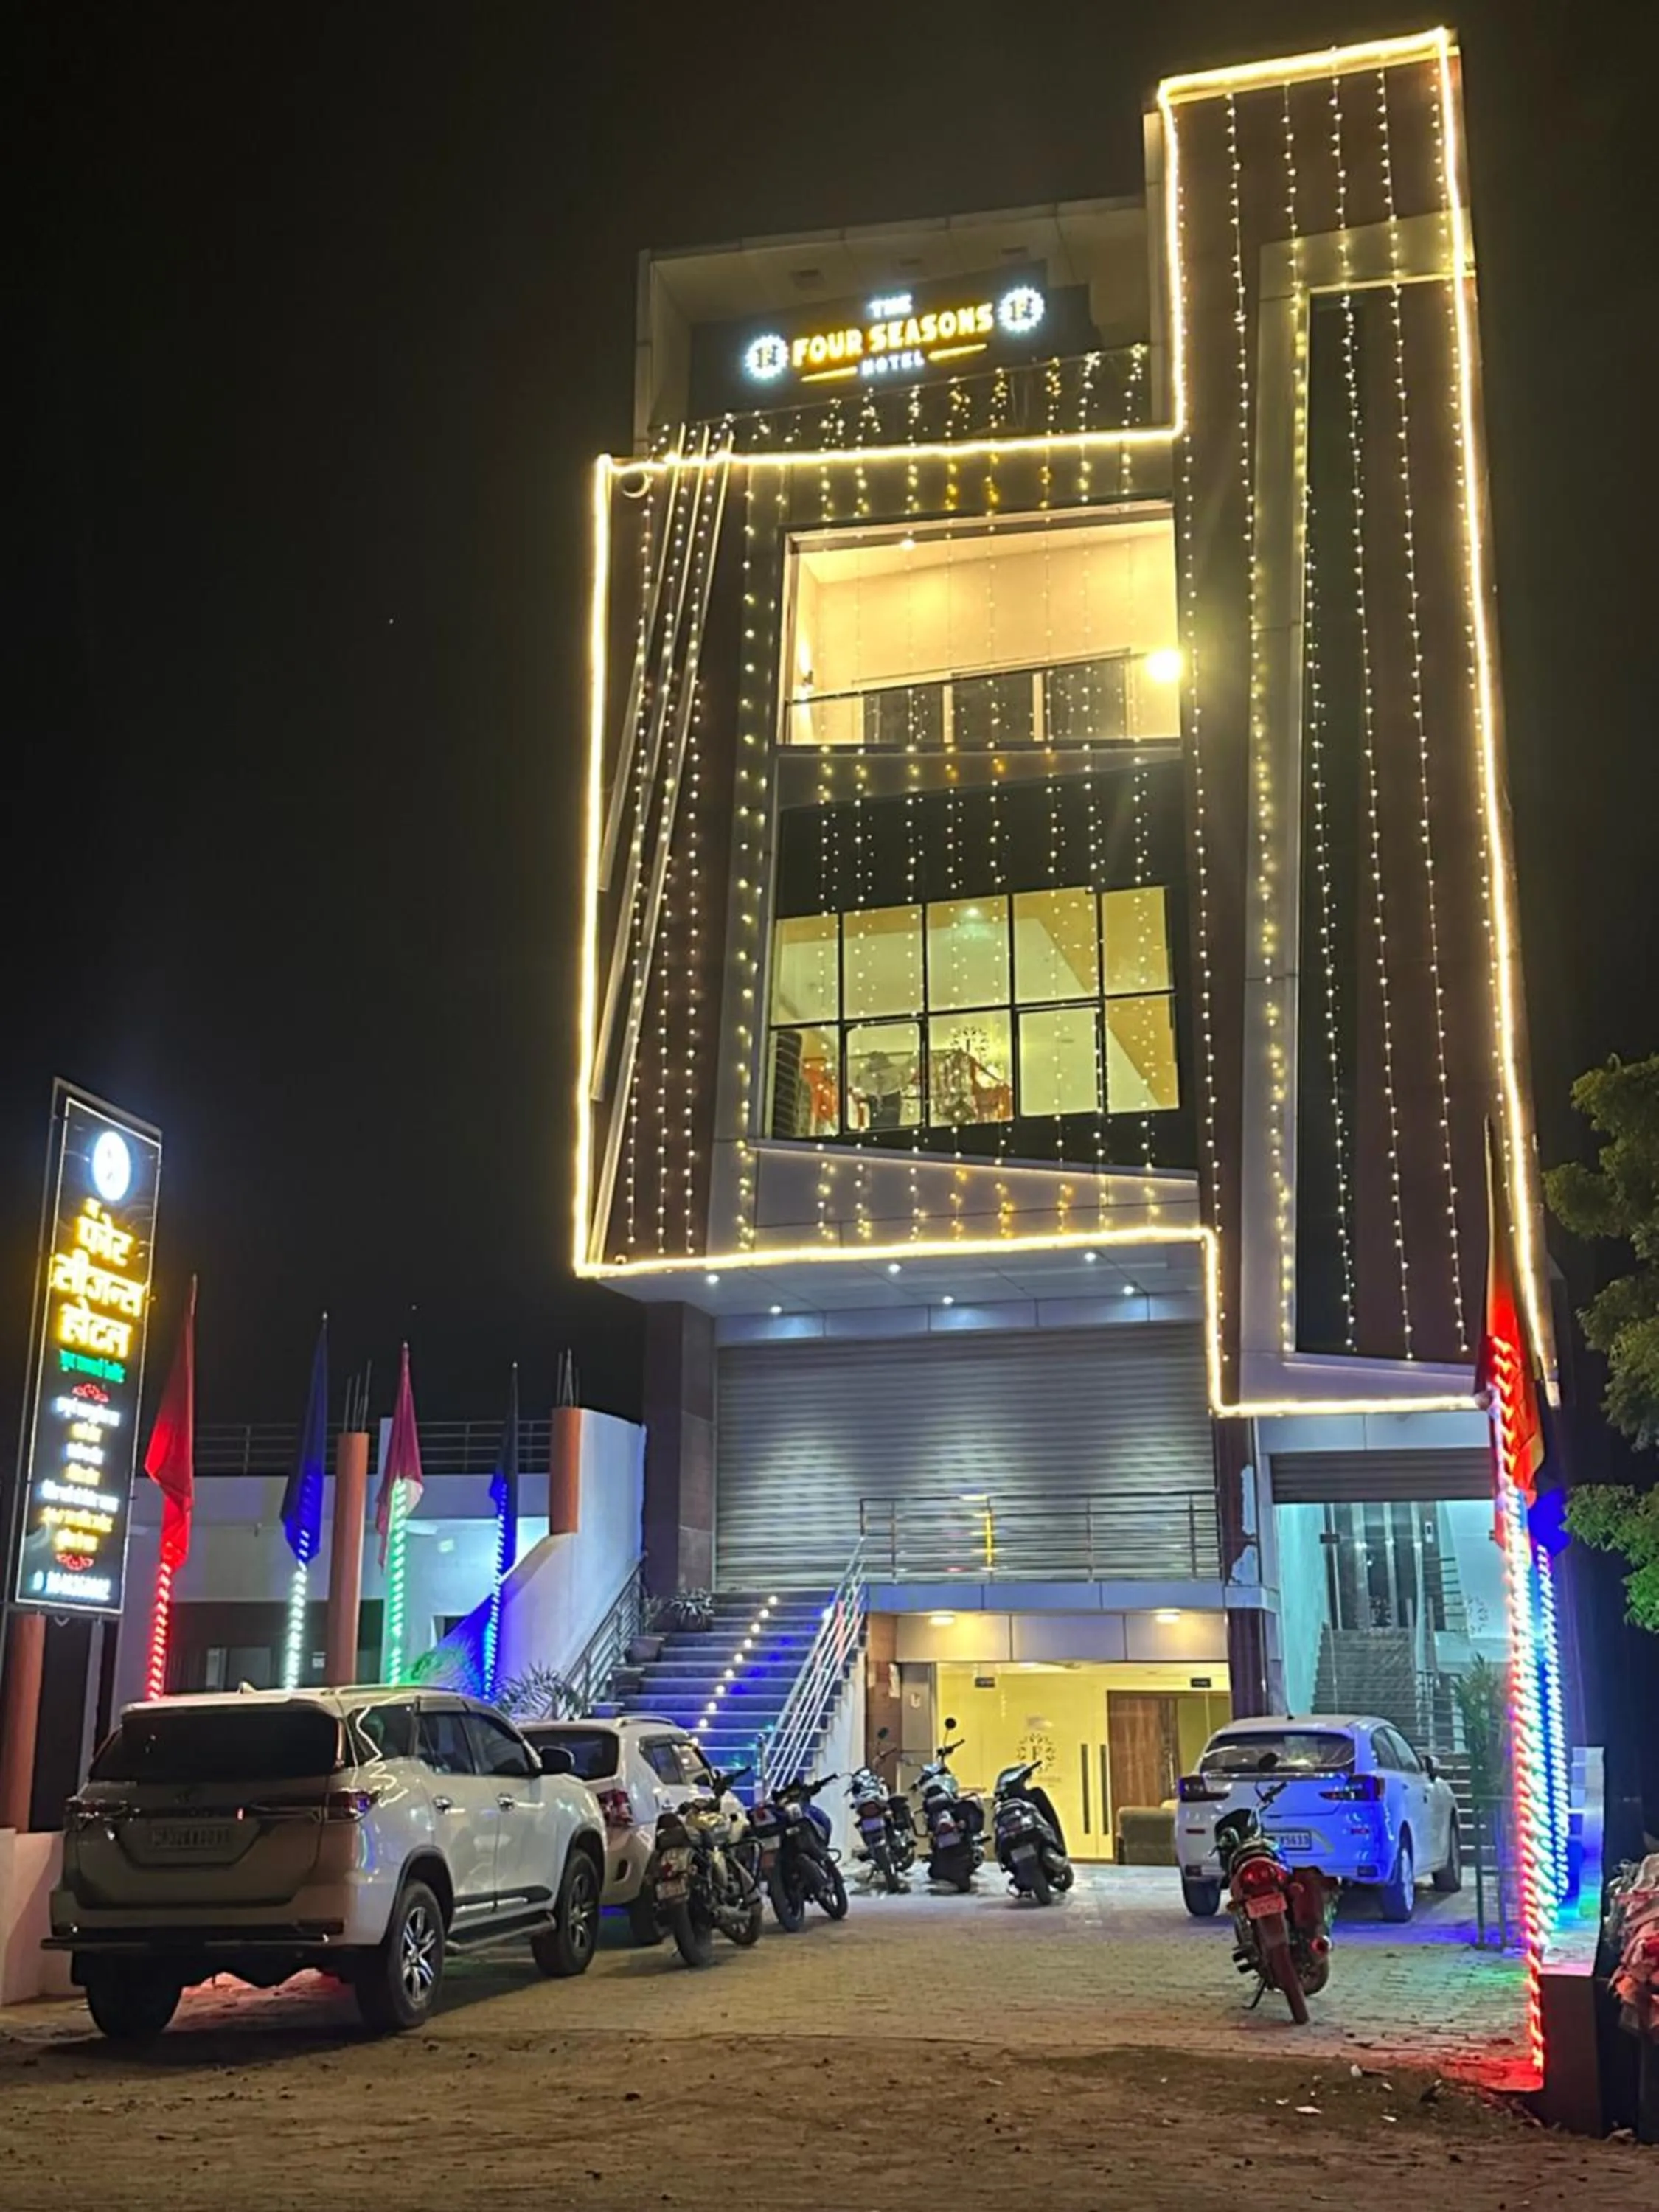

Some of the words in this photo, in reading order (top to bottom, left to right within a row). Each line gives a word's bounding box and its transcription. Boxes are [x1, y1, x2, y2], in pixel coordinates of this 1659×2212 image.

[792, 329, 863, 367] FOUR
[868, 302, 994, 352] SEASONS
[860, 350, 925, 376] HOTEL
